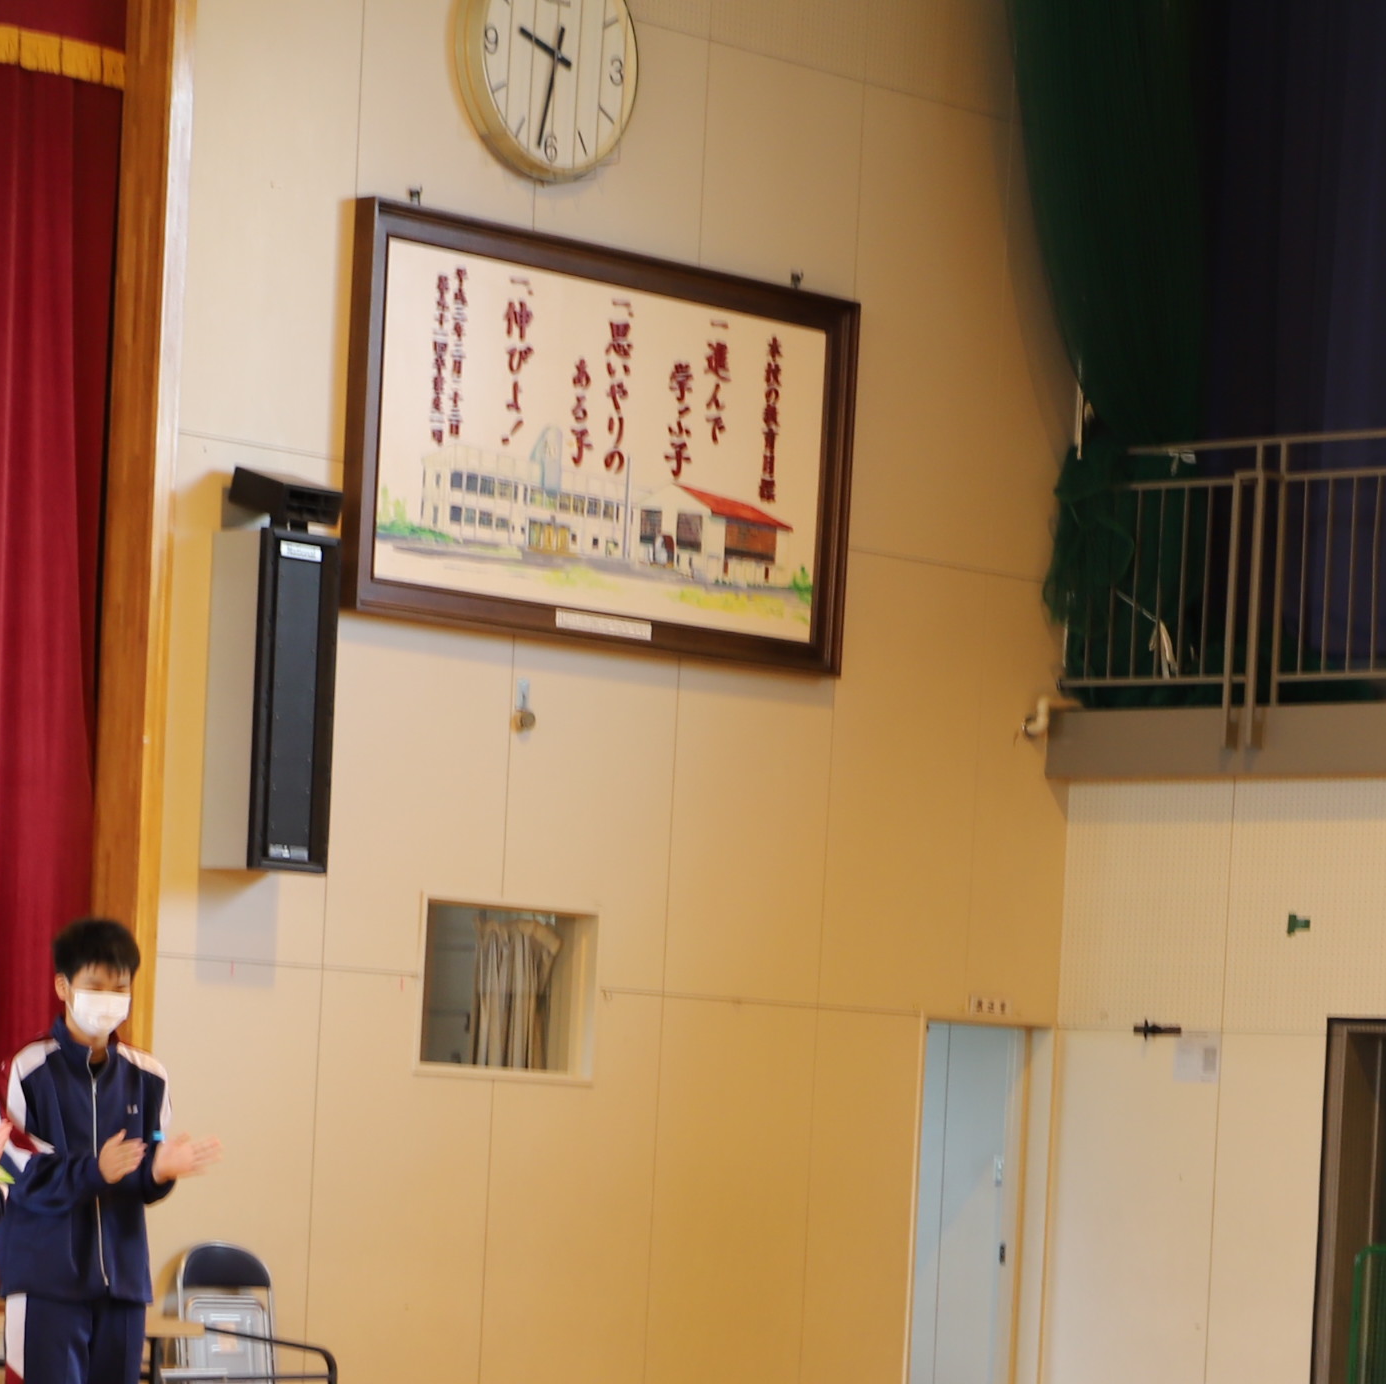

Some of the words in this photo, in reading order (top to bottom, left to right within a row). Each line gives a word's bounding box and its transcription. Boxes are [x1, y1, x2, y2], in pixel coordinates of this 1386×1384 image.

[609, 58, 624, 87] 3
[543, 135, 558, 163] 6
[570, 357, 595, 467] ある子
[664, 361, 694, 480] 学ぶ子
